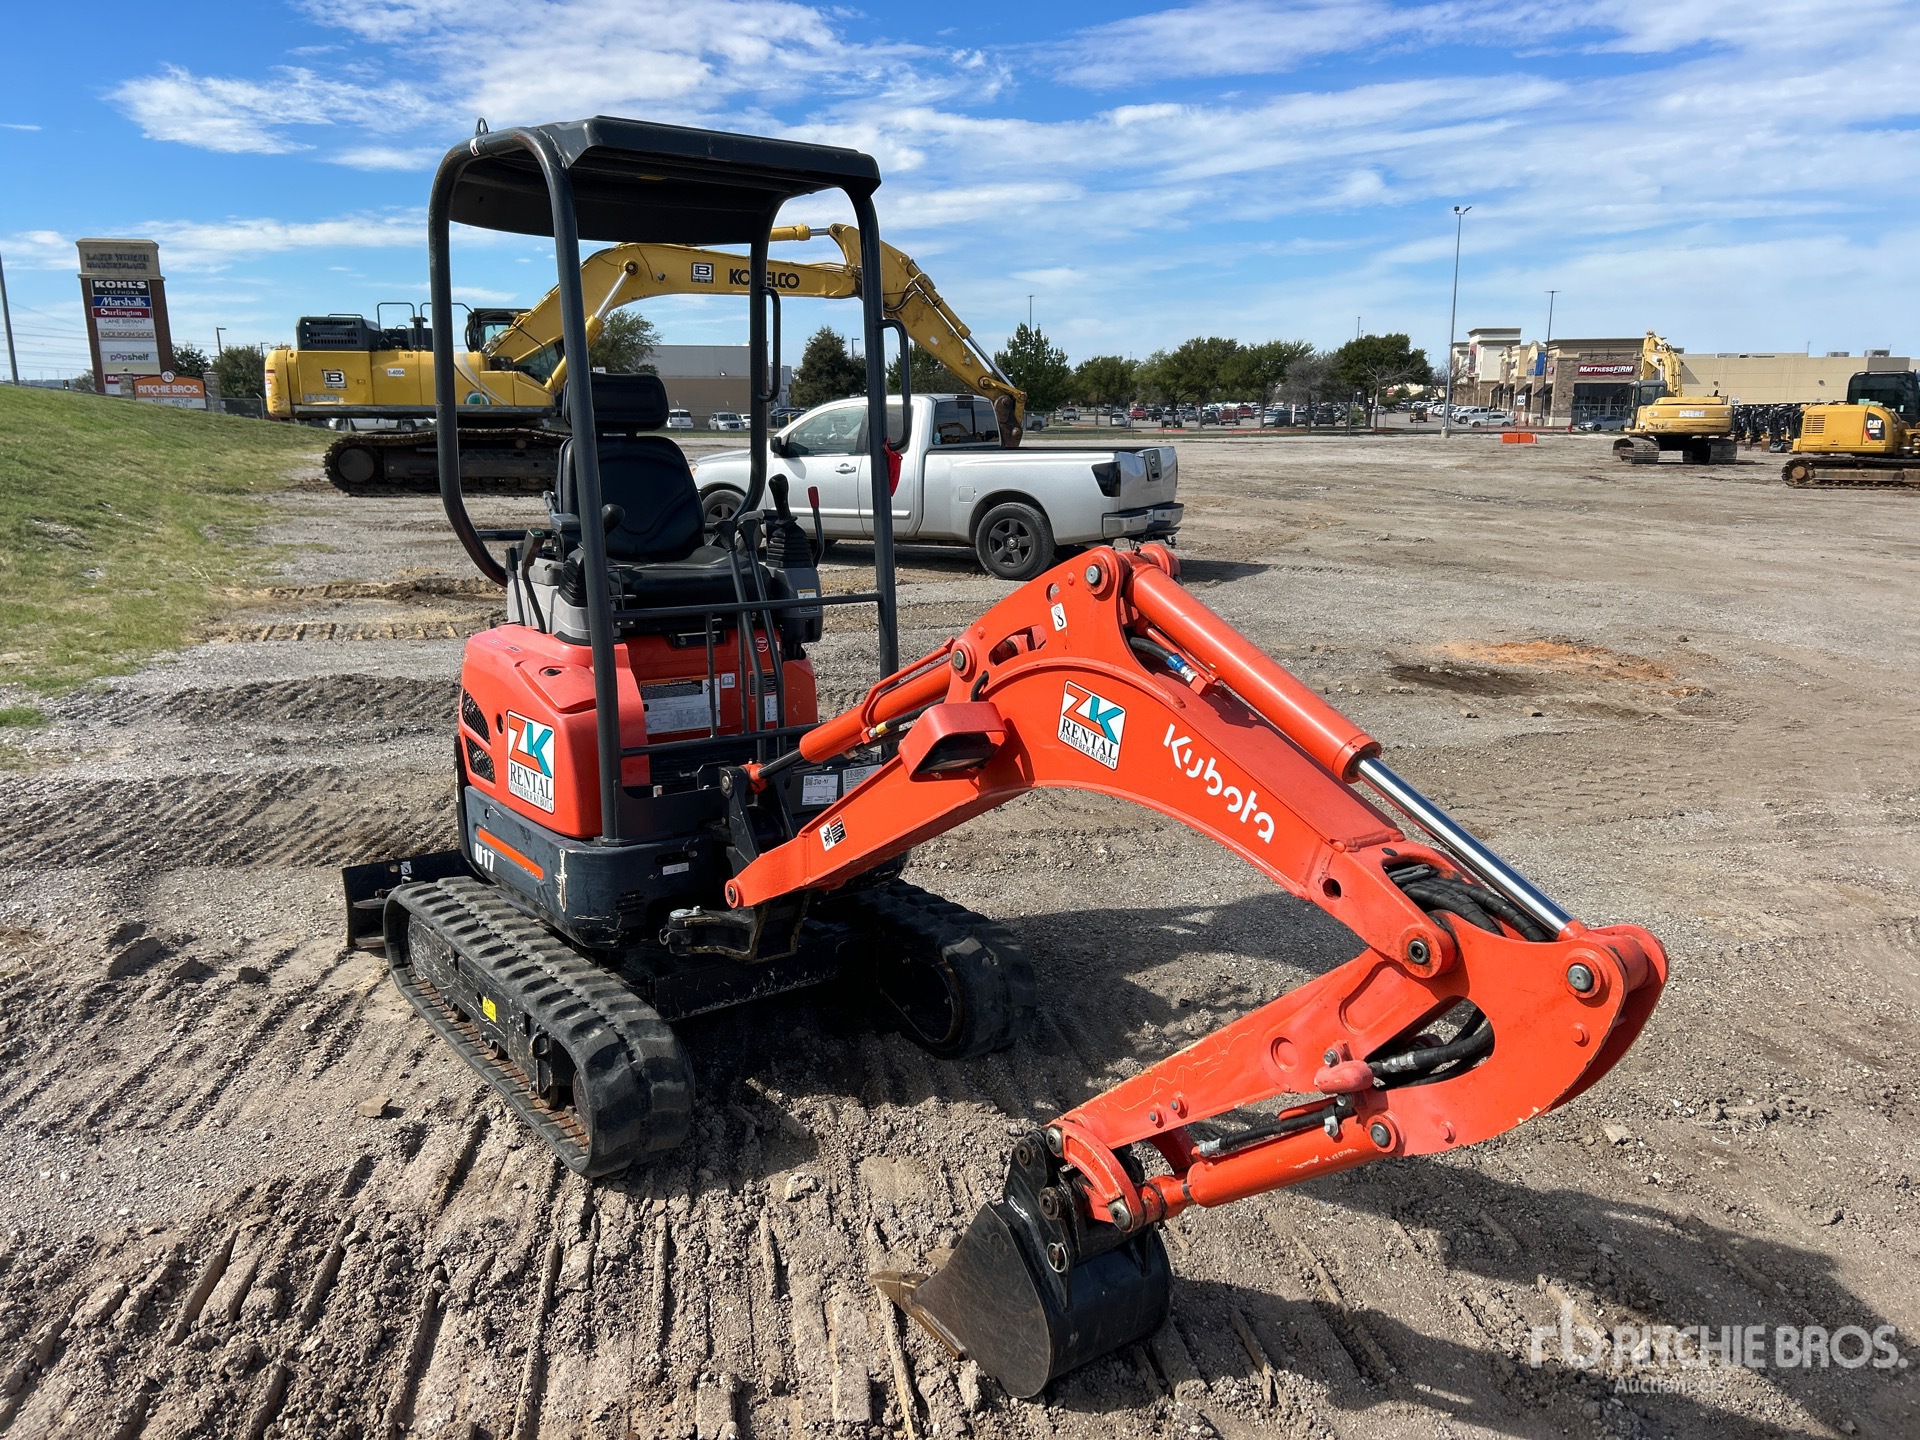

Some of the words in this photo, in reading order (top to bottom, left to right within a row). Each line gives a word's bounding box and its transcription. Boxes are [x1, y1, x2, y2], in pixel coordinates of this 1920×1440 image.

[94, 280, 147, 289] KOHL'S
[729, 268, 800, 289] KOELCO
[100, 296, 146, 307] Marshalls
[100, 308, 143, 318] Burlington
[110, 353, 150, 361] popshelf
[137, 385, 171, 394] RITCHIE
[172, 385, 201, 394] BROS.
[1867, 420, 1883, 428] CAT
[1063, 682, 1124, 745] ZK
[509, 713, 553, 778] ZK
[1059, 731, 1091, 755] ZIMMERER
[1091, 749, 1115, 768] KUBOTA
[1061, 718, 1116, 761] RENTAL
[510, 762, 552, 801] RENTAL
[1163, 723, 1275, 844] Kubota
[475, 842, 494, 873] U17
